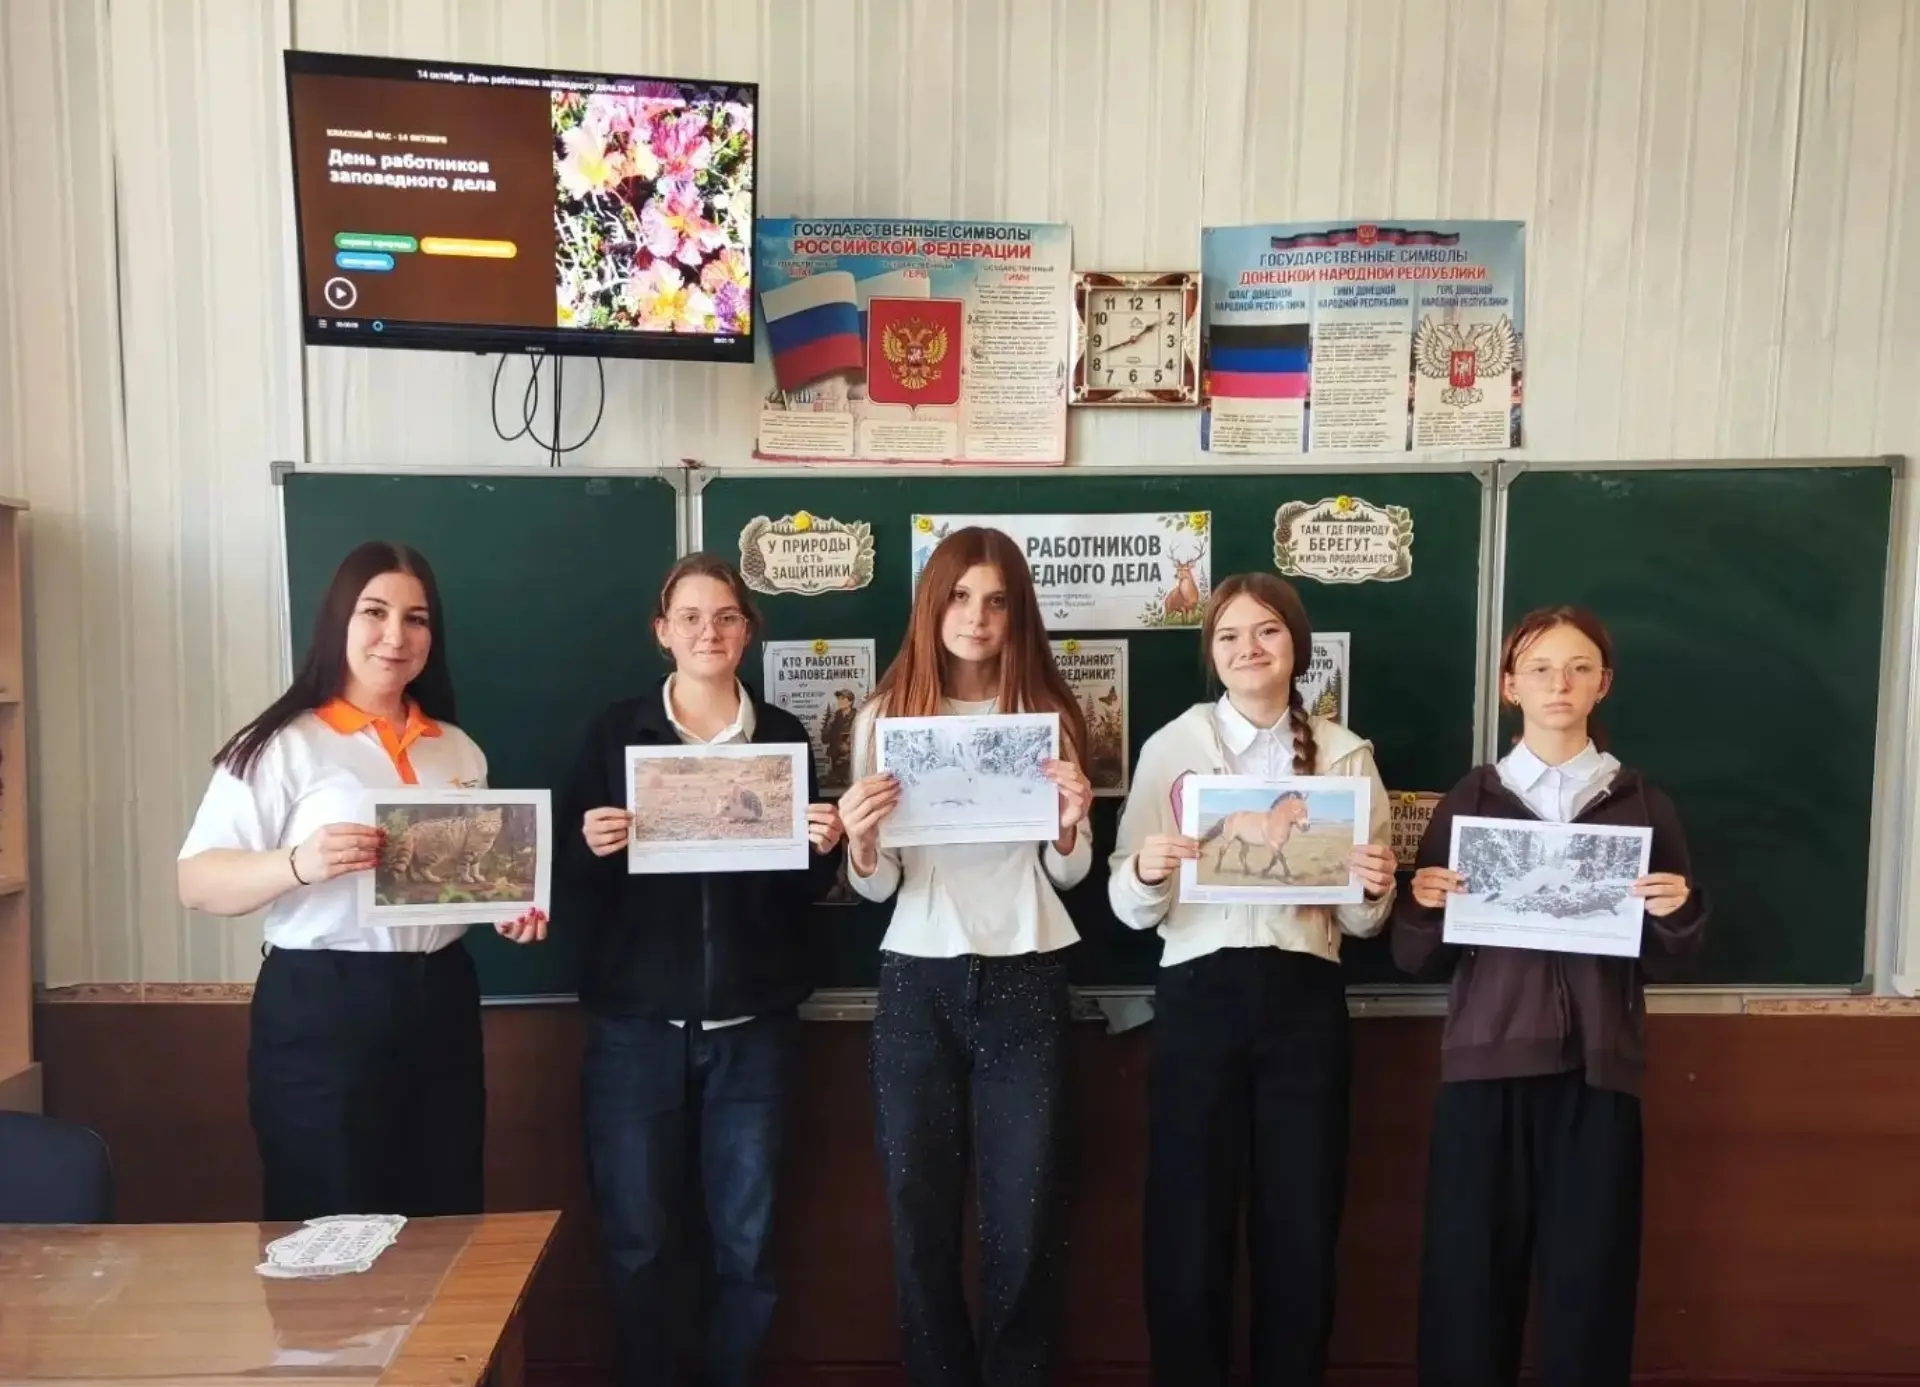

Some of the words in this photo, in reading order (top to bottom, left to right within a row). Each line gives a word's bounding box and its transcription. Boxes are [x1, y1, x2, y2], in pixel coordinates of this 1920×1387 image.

[417, 69, 428, 79] 14
[328, 149, 376, 166] День
[381, 153, 490, 173] работников
[330, 169, 448, 189] заповедного
[452, 178, 497, 192] дела
[794, 223, 947, 238] ГОСУДАРСТВЕННЫЕ
[952, 227, 1031, 240] СИМВОЛЫ
[794, 238, 916, 255] РОССИЙСКОЙ
[922, 241, 1031, 259] ФЕДЕРАЦИИ
[1259, 250, 1397, 267] ГОСУДАРСТВЕННЫЕ
[1400, 249, 1468, 263] СИМВОЛЫ
[1239, 266, 1316, 285] ДОНЕЦКОЙ
[1319, 265, 1394, 282] НАРОДНОЙ
[1398, 265, 1487, 281] РЕСПУБЛИКИ
[1104, 298, 1115, 310] 11
[1129, 297, 1143, 310] 12
[1155, 298, 1161, 310] 1
[1094, 312, 1107, 325] 10
[1167, 312, 1175, 325] 2
[1093, 334, 1102, 347] 9
[1167, 334, 1175, 347] 3
[1092, 358, 1101, 371] 8
[1165, 358, 1174, 370] 4
[1106, 370, 1114, 382] 7
[1129, 369, 1138, 382] 6
[1154, 369, 1162, 382] 5
[1326, 525, 1344, 536] ГДЕ
[1346, 525, 1390, 536] ПРИРОДУ
[768, 540, 776, 554] У
[783, 538, 851, 553] ПРИРОДЫ
[1026, 535, 1162, 558] РАБОТНИКОВ
[1310, 537, 1371, 551] БЕРЕГУТ
[796, 554, 823, 563] ЕСТЬ
[1298, 554, 1327, 563] ЖИЗНЬ
[1329, 554, 1393, 563] ПРОДОЛЖАЕТСЯ
[772, 564, 850, 579] ЗАЩИТНИКИ
[1031, 563, 1105, 587] ЕДНОГО
[1110, 562, 1162, 586] ДЕЛА
[782, 657, 801, 668] КТО
[806, 655, 856, 667] РАБОТАЕТ
[1054, 654, 1115, 666] СОХРАНЯЮТ
[779, 670, 785, 681] В
[788, 668, 865, 681] ЗАПОВЕДНИКЕ?
[1060, 668, 1115, 682] ВЕДНИКИ?
[1392, 806, 1432, 820] РАНЯЕ
